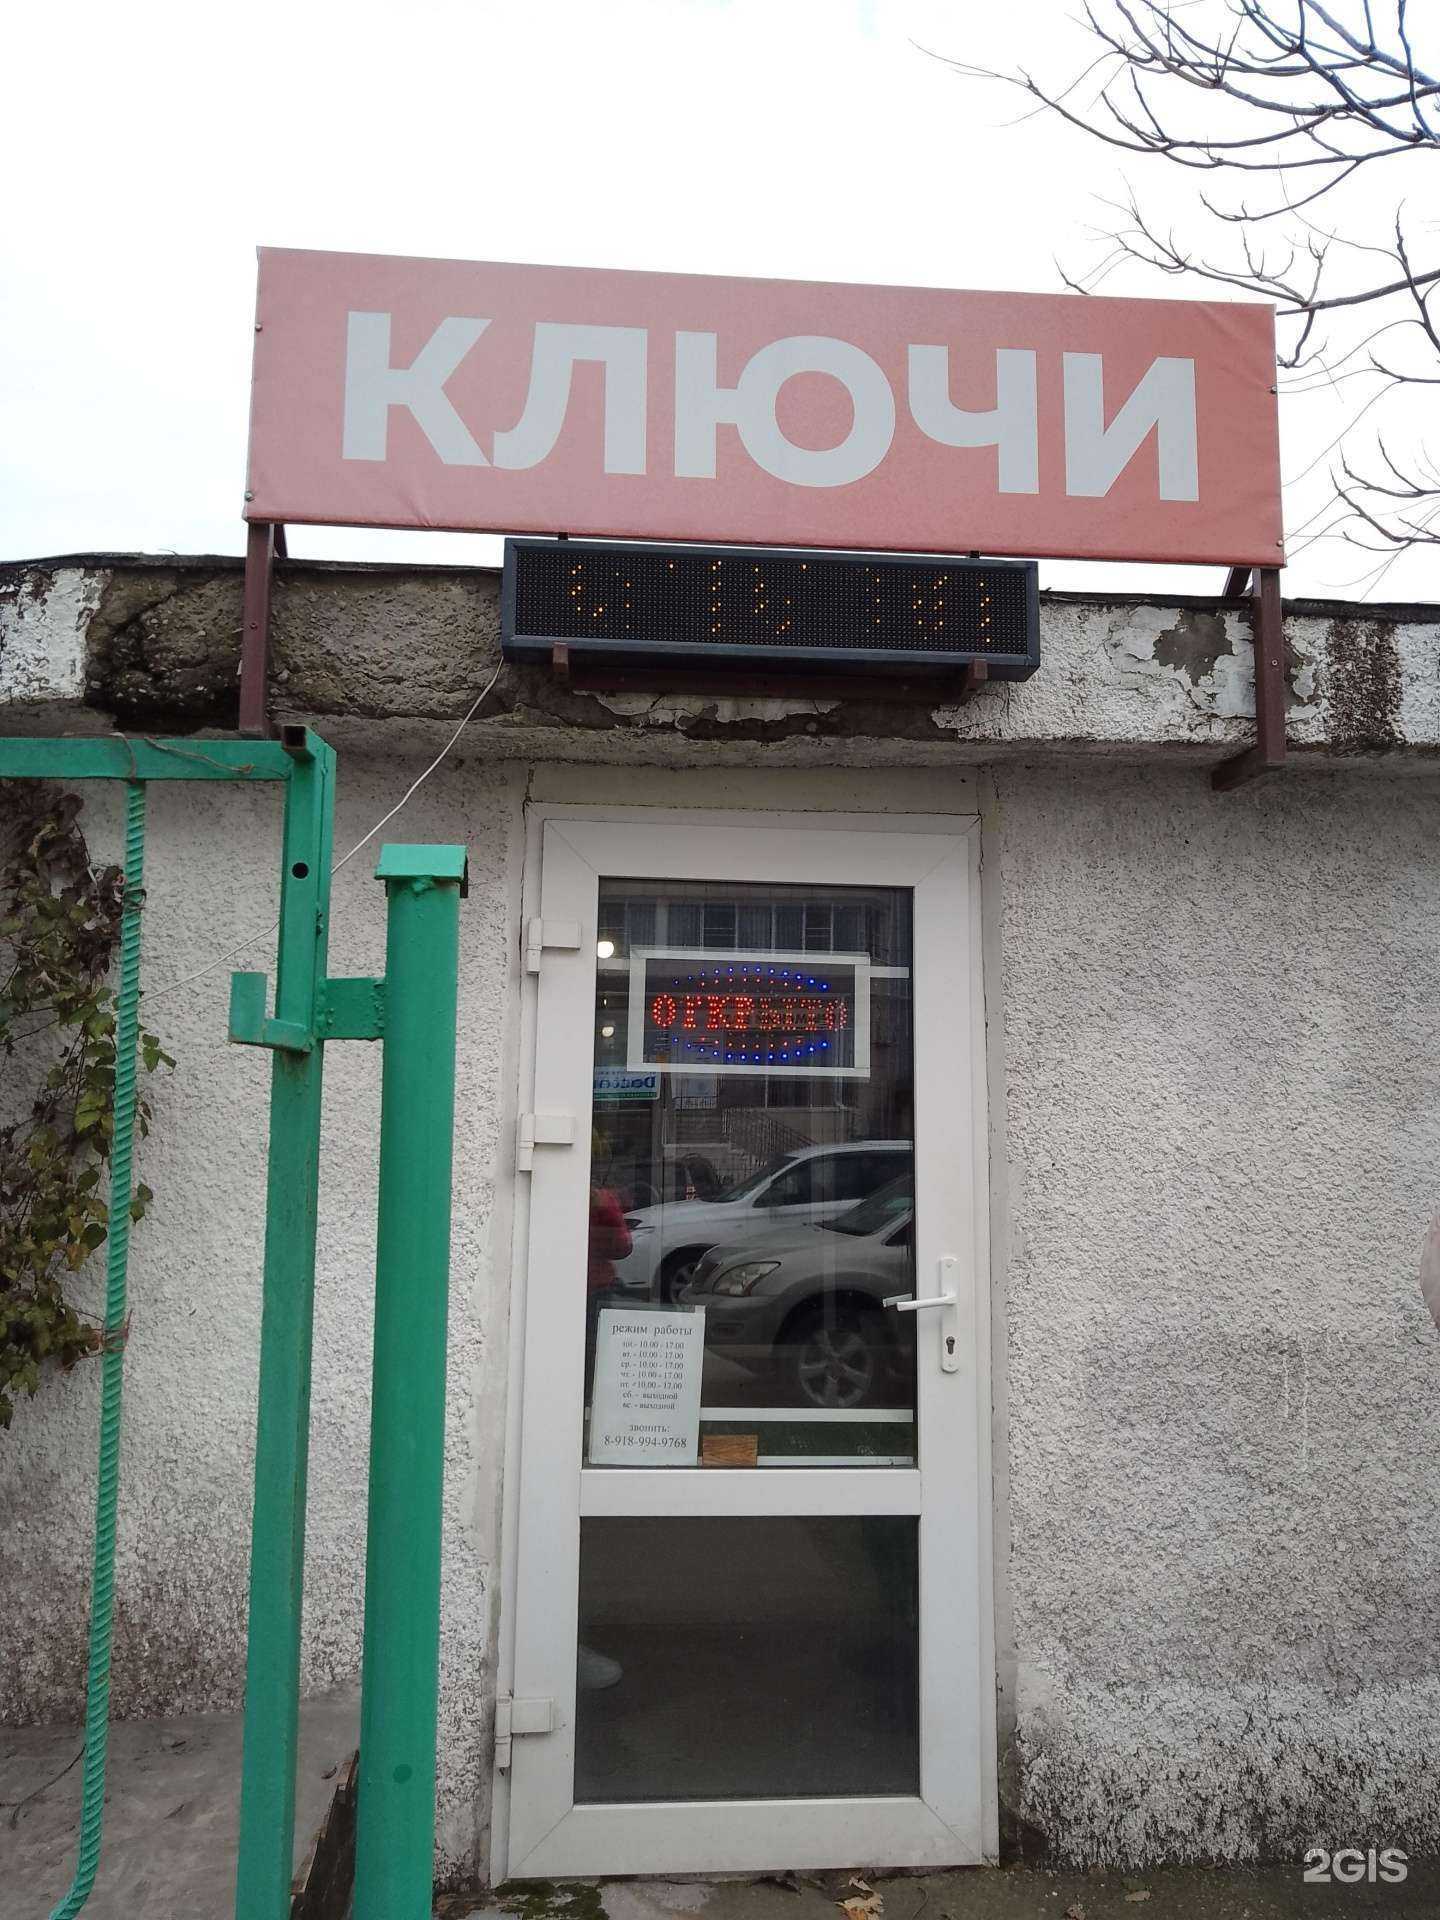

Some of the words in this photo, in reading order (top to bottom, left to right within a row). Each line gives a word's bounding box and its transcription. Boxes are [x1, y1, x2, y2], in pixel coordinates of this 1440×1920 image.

[342, 310, 1200, 502] КЛЮЧИ
[651, 993, 848, 1032] ОТКРЫТО
[612, 1325, 648, 1335] режим
[654, 1324, 693, 1337] работы
[604, 1435, 687, 1448] 8-918-994-9768
